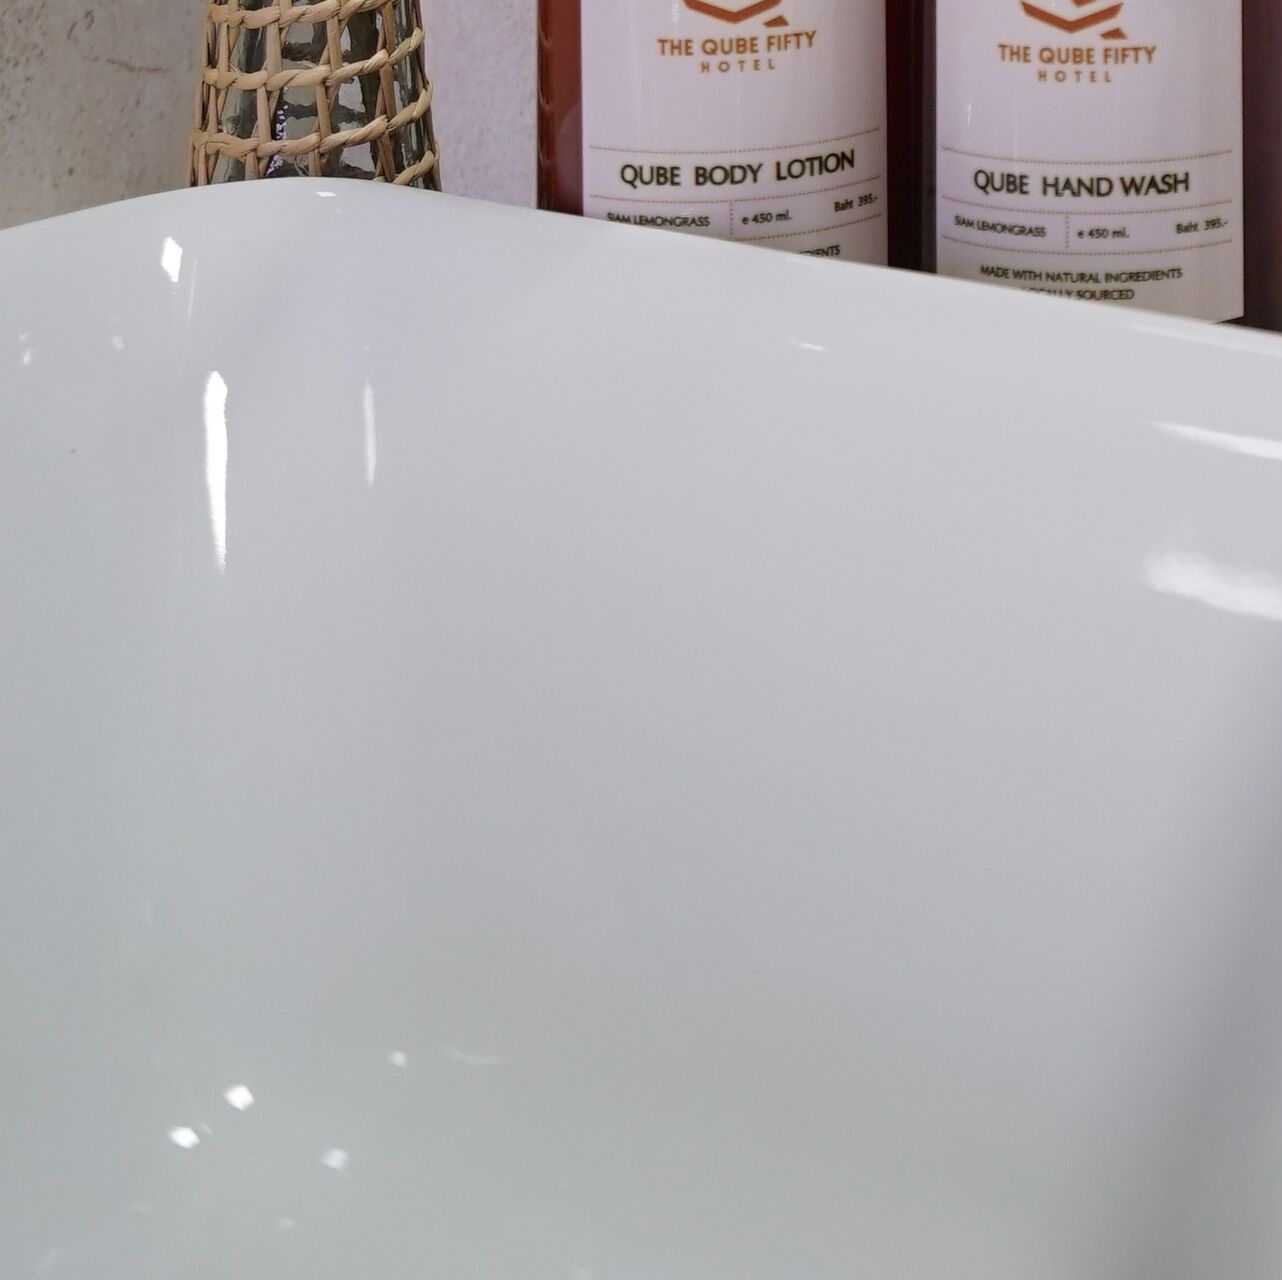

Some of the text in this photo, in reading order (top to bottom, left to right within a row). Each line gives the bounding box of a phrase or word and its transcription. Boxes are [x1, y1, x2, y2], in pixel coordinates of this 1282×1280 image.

[658, 31, 816, 56] THE QUBE FIFTY
[998, 44, 1156, 65] THE QUBE FIFTY
[701, 59, 775, 73] HOTEL
[1038, 70, 1112, 82] HOTEL
[620, 149, 855, 189] QUBE BODY LOTION
[974, 169, 1189, 197] QUBE HAND WASH
[752, 213, 772, 224] 450
[775, 210, 792, 222] ml.
[954, 215, 1047, 238] SIAM LEMONGRASS
[1088, 228, 1109, 239] 450
[980, 265, 1183, 284] MADE WITH NATURAL INGREDIENTS
[1077, 289, 1135, 301] SOURCED
